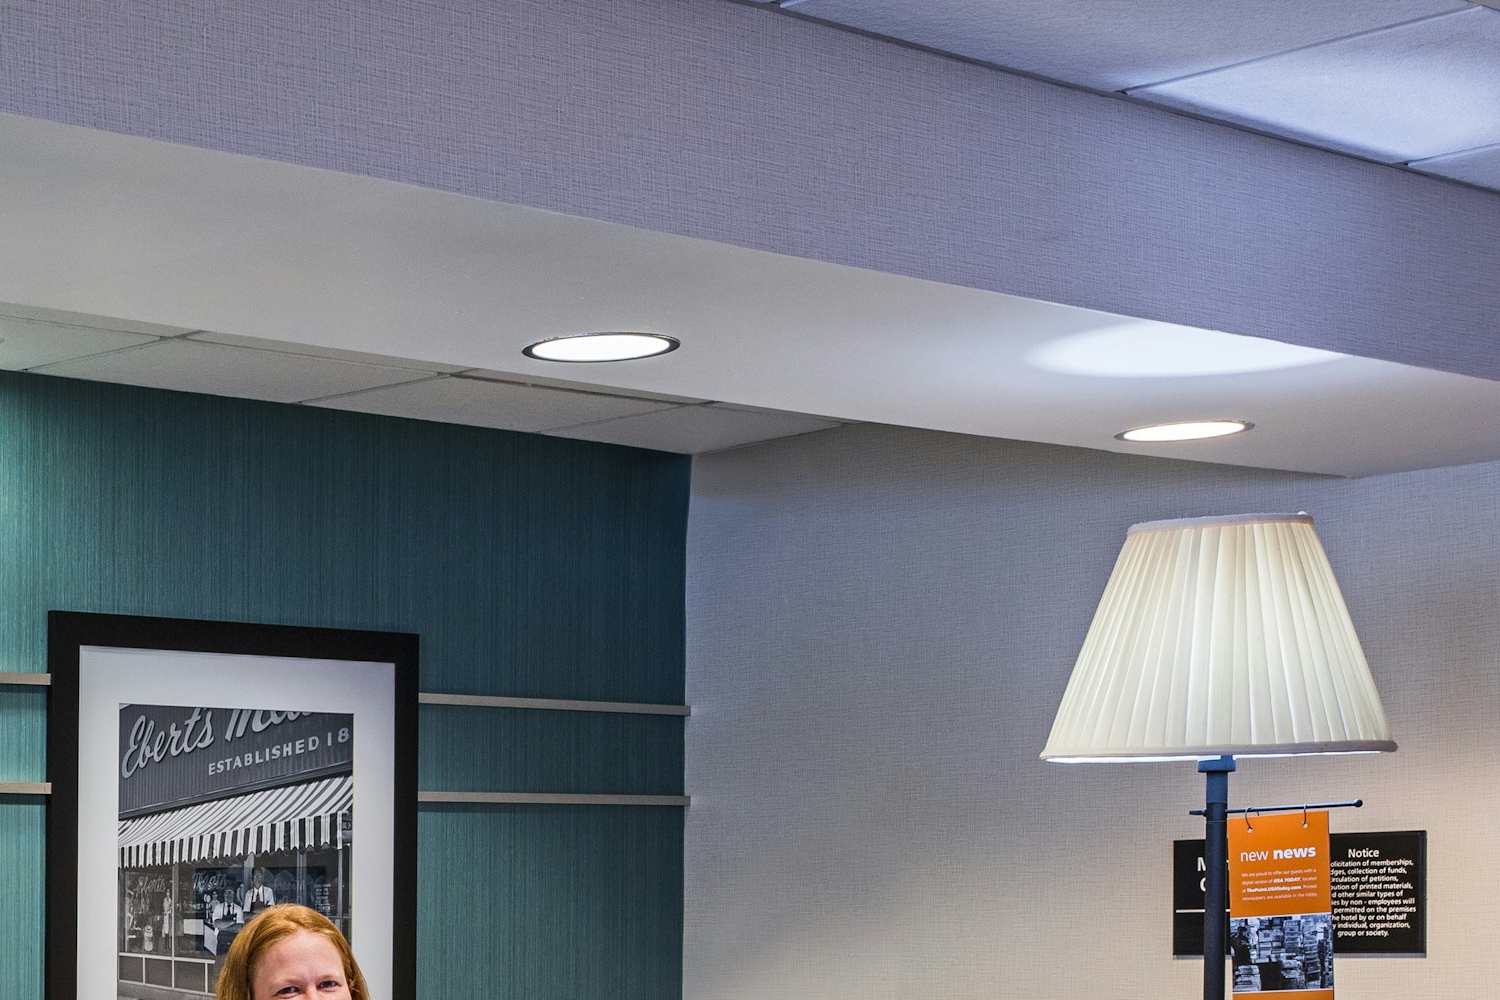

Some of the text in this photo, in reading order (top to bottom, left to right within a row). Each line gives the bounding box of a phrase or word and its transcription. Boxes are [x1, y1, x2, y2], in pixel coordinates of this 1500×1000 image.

[121, 707, 215, 779] Eberts
[208, 735, 320, 776] ESTABLISHED
[1240, 846, 1317, 862] new news
[1348, 848, 1380, 859] Notice
[1362, 859, 1369, 867] of
[1370, 858, 1414, 868] memberships,
[1347, 867, 1378, 875] collection
[1379, 866, 1387, 874] of
[1387, 866, 1408, 875] funds,
[1369, 875, 1399, 883] petitions,
[1359, 882, 1382, 892] printed
[1383, 882, 1413, 890] materials,
[1337, 890, 1355, 898] other
[1356, 890, 1376, 898] similar
[1377, 890, 1395, 899] types
[1396, 889, 1404, 897] of
[1341, 898, 1349, 907] by
[1368, 897, 1401, 907] employees
[1402, 897, 1415, 905] will
[1334, 906, 1365, 915] permitted
[1388, 905, 1416, 914] premises
[1358, 914, 1367, 922] by
[1386, 912, 1407, 921] behalf
[1369, 921, 1410, 930] organization,
[1337, 930, 1356, 938] group
[1365, 929, 1389, 938] society.
